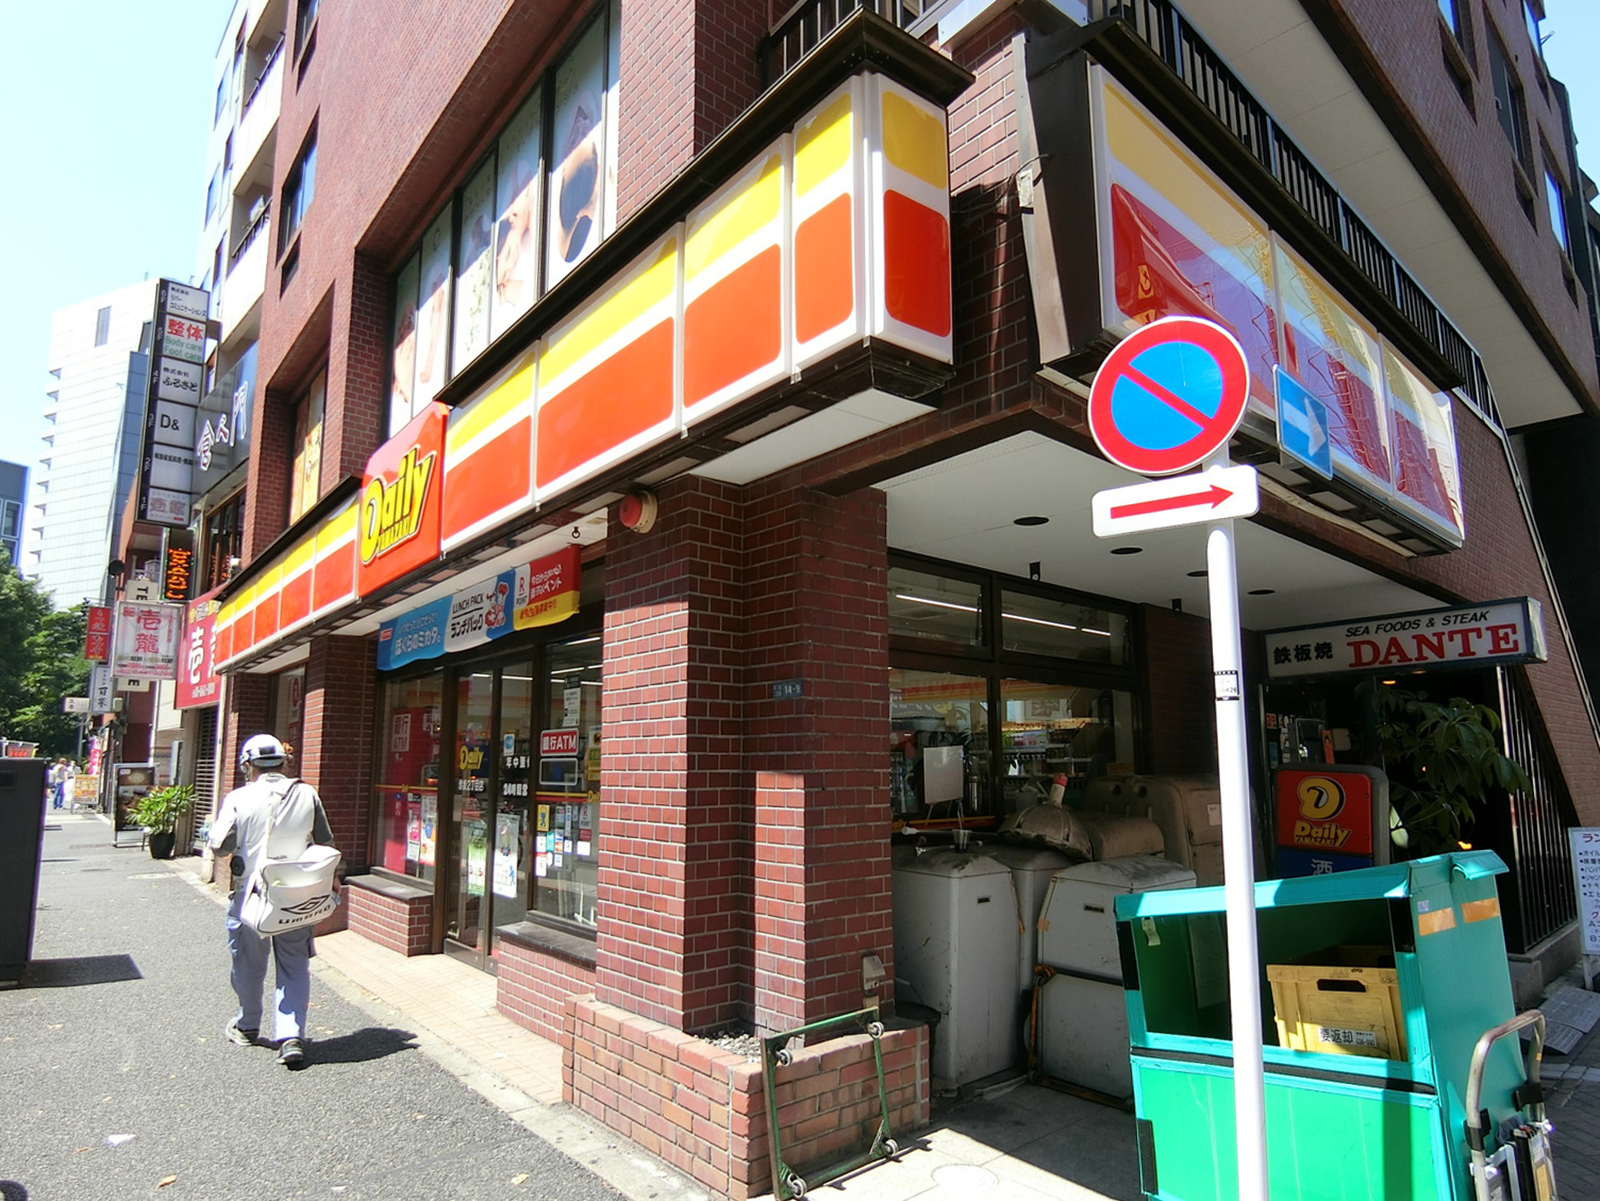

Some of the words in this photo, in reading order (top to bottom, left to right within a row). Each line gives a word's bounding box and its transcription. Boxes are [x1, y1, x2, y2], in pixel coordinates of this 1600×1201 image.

[167, 318, 203, 341] 整体
[164, 345, 183, 355] Foot
[184, 351, 202, 361] care
[165, 335, 184, 348] Body
[185, 342, 203, 351] care
[162, 376, 198, 392] ふるさと
[160, 414, 180, 431] D&
[361, 447, 434, 563] Daily
[452, 598, 470, 614] LUNCH
[470, 593, 484, 605] PACK
[135, 608, 161, 655] 壱龍
[451, 613, 484, 638] ランチパック
[1345, 627, 1370, 638] SEA
[1375, 619, 1421, 634] FOODS
[1425, 617, 1436, 629] &
[1441, 610, 1490, 626] STEAK
[1273, 641, 1333, 665] 鉄板焼
[1347, 623, 1520, 668] DANTE
[460, 745, 484, 770] Daily
[1295, 821, 1352, 847] Daily
[1320, 1028, 1354, 1044] 要返却
